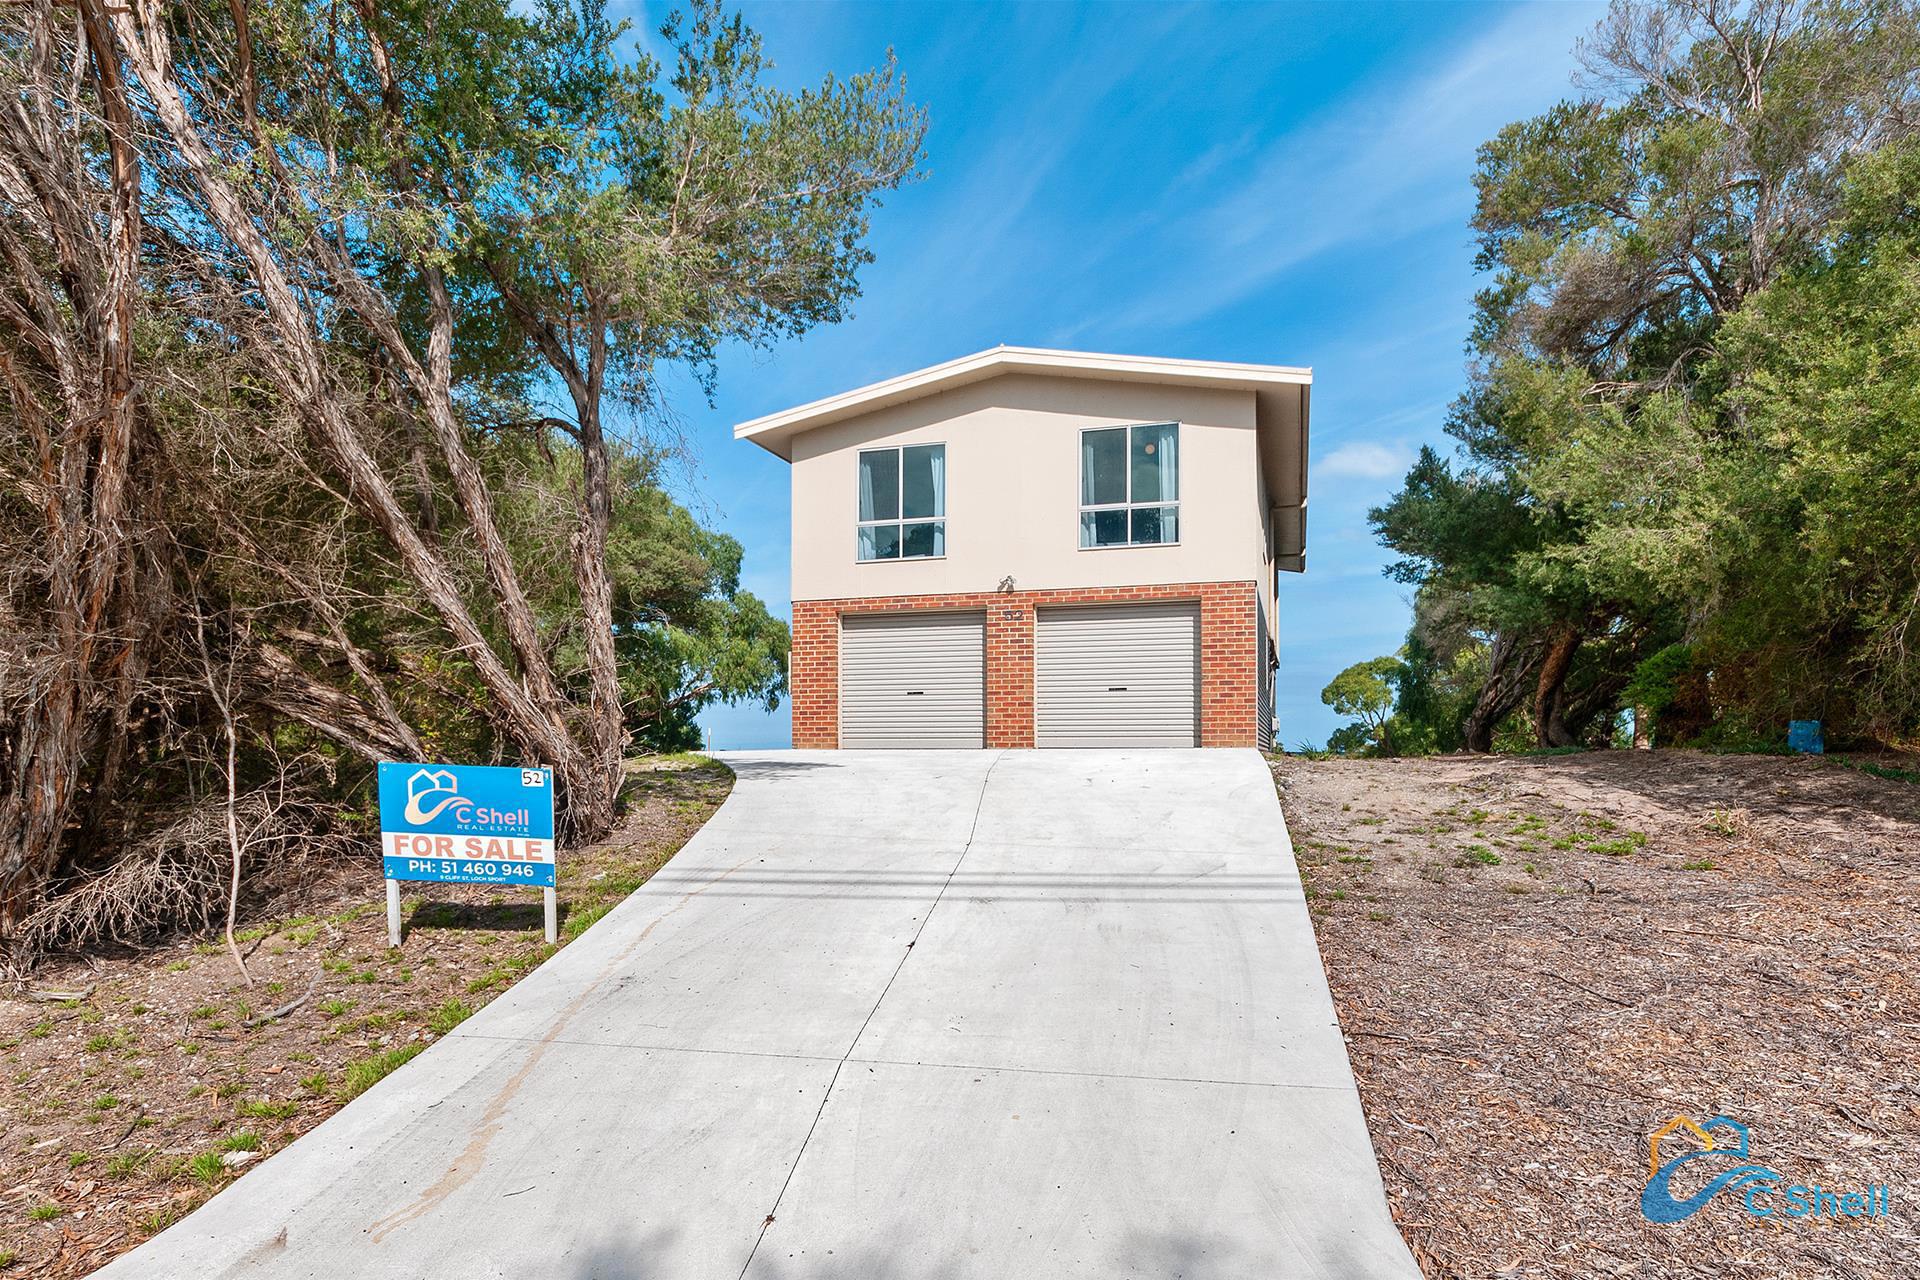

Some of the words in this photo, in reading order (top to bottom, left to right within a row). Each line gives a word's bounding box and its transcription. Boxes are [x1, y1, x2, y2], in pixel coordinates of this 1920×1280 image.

[1002, 610, 1024, 621] 52
[522, 771, 542, 785] 52
[456, 807, 471, 823] C
[476, 808, 529, 826] Shell
[490, 825, 529, 833] ESTATE
[394, 835, 455, 859] FOR
[465, 838, 543, 861] SALE
[409, 860, 436, 873] PH:
[441, 861, 457, 874] 51
[463, 862, 496, 875] 460
[502, 863, 534, 877] 946
